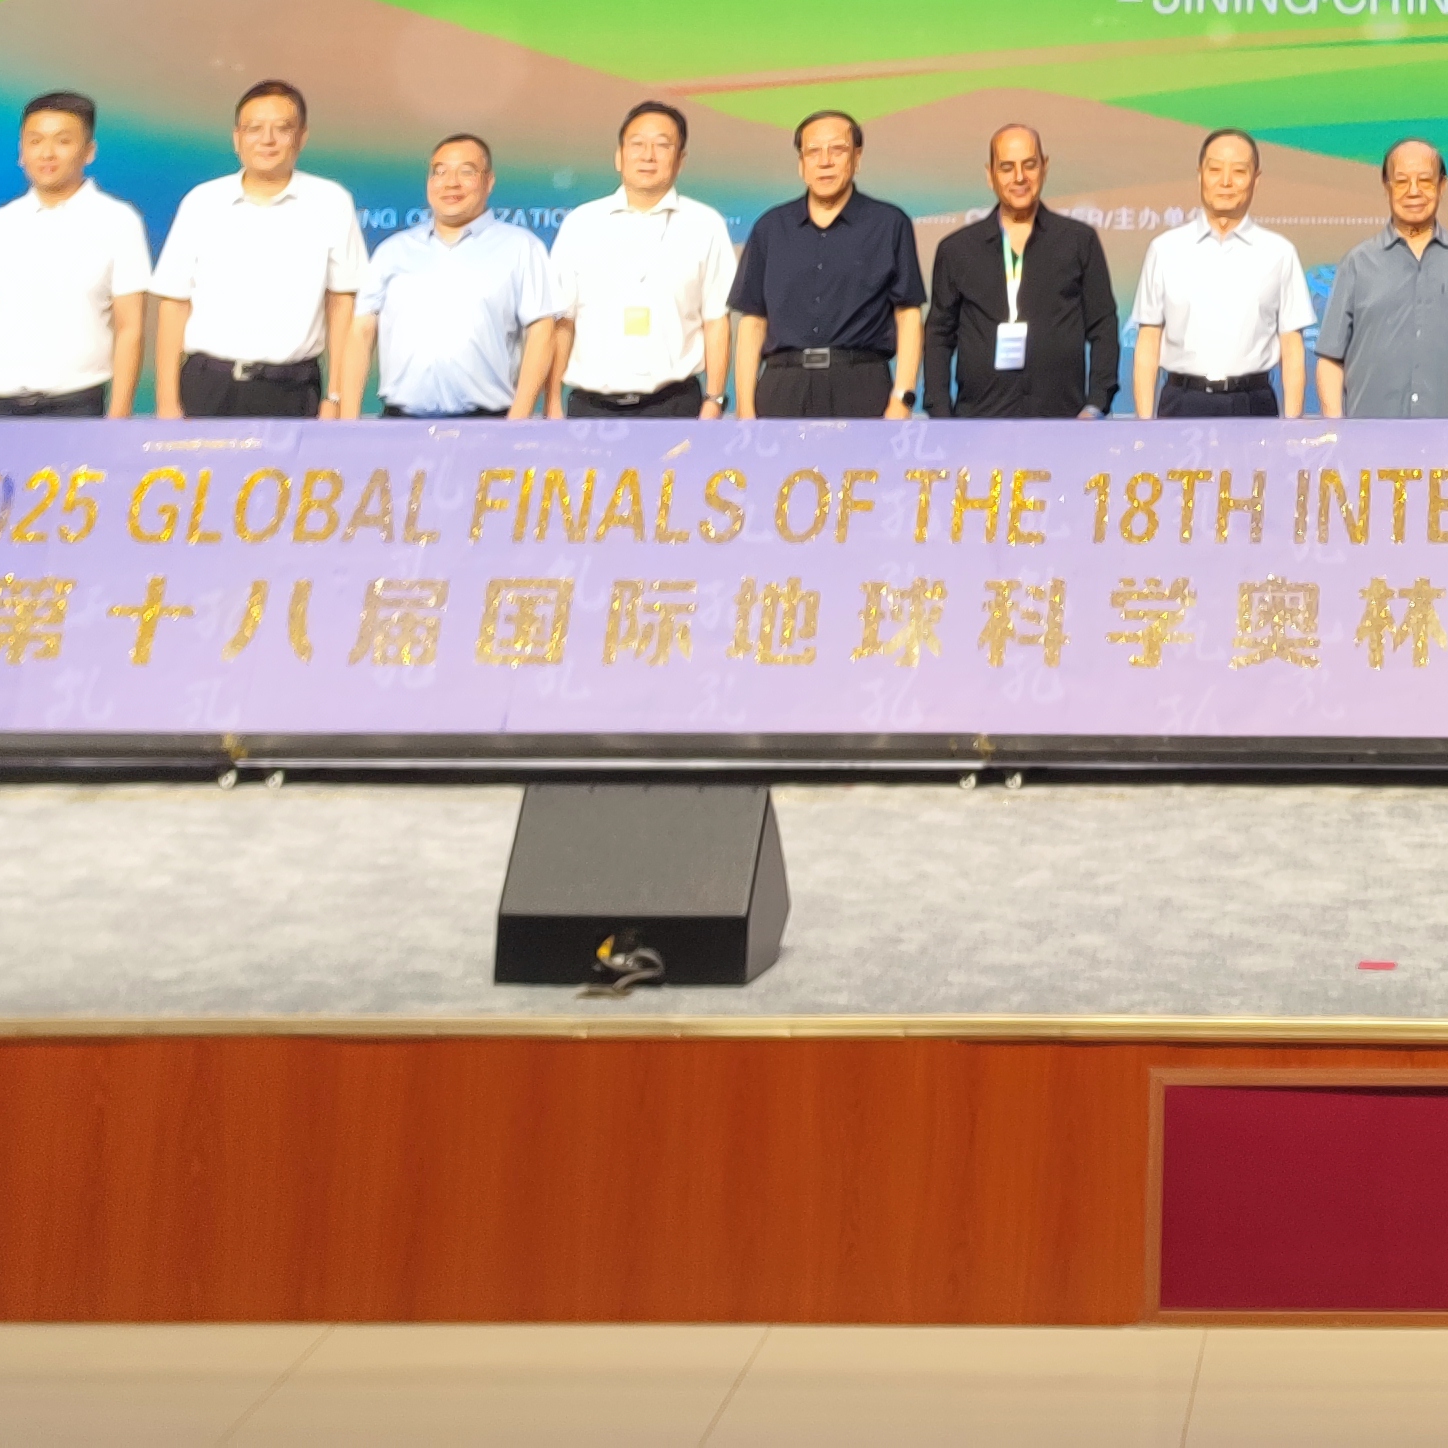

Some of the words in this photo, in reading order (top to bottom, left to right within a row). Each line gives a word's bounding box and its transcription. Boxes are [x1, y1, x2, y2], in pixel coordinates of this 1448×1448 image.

[125, 465, 441, 545] GLOBAL
[469, 467, 748, 544] FINALS
[774, 467, 882, 544] OF
[904, 467, 1052, 546] THE
[1083, 467, 1267, 546] 18TH
